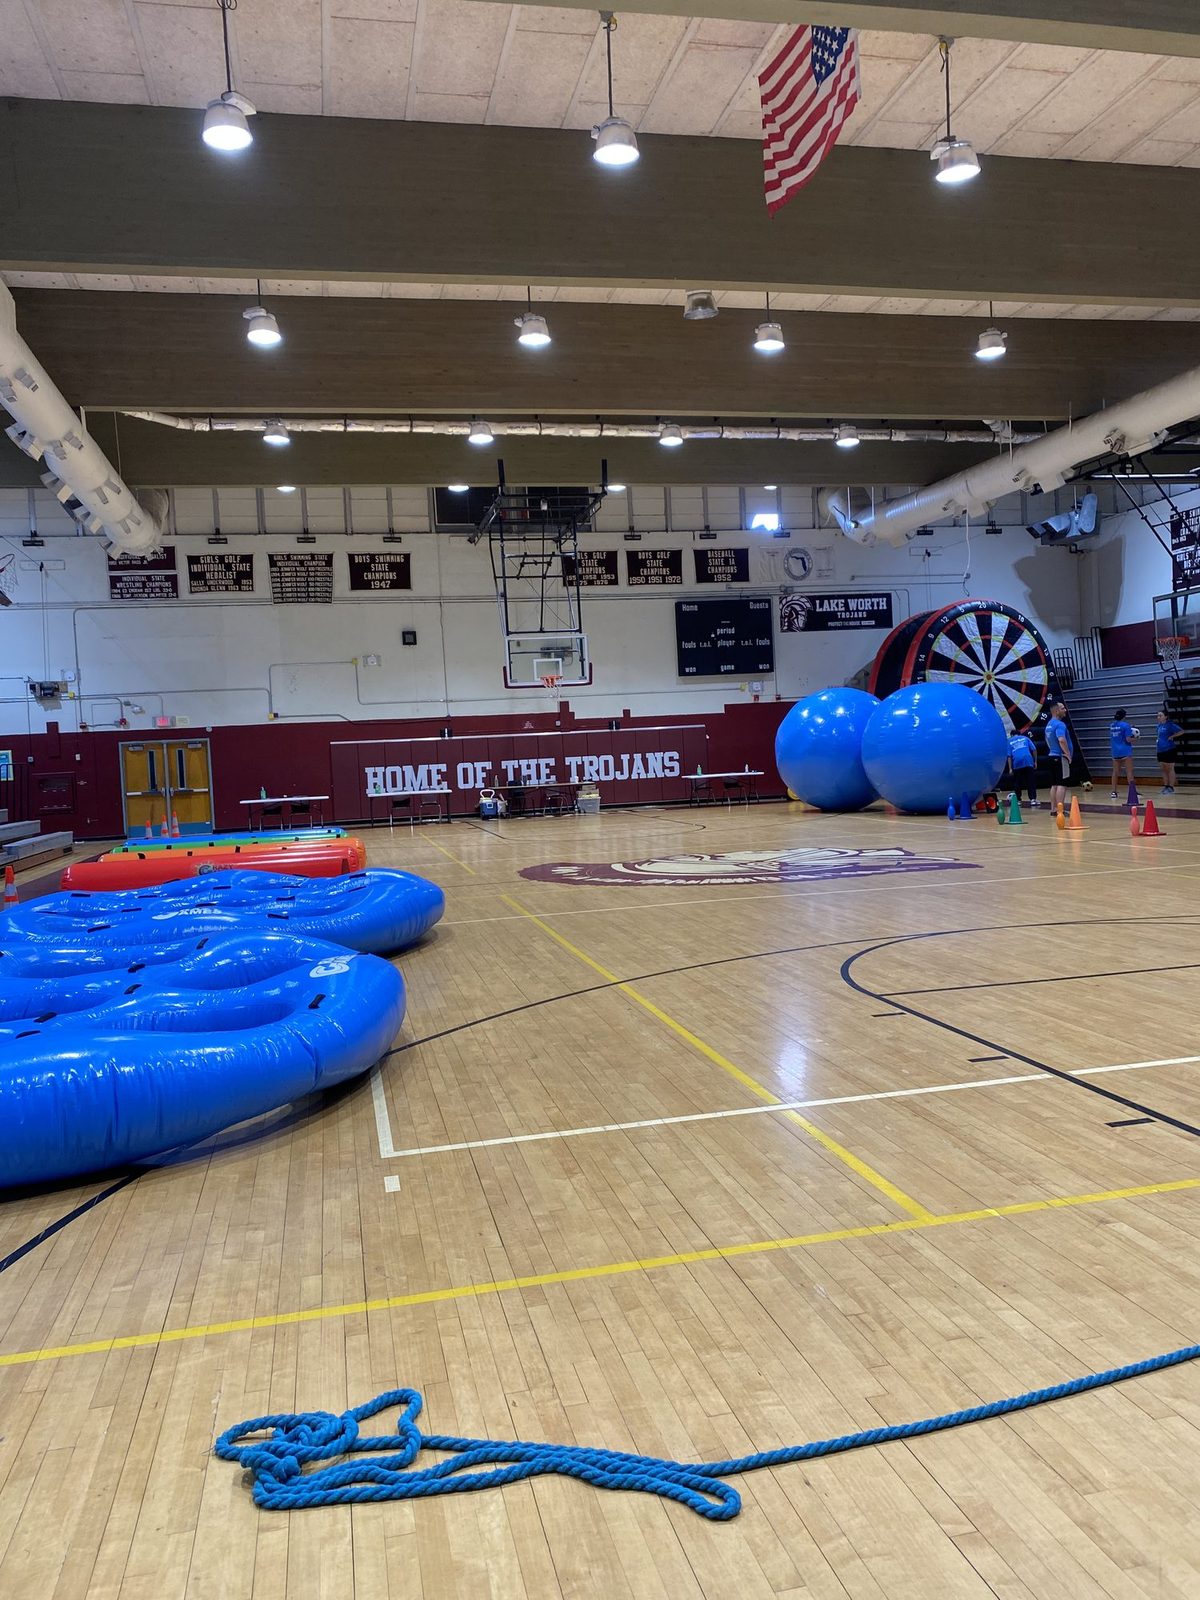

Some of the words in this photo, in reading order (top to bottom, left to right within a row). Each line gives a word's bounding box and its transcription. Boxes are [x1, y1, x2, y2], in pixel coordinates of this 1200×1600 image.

[191, 564, 226, 572] INDIVIDUAL
[815, 599, 845, 611] LAKE
[848, 598, 887, 610] WORTH
[717, 627, 735, 635] period
[365, 764, 448, 794] HOME
[457, 761, 492, 789] OF
[502, 758, 556, 786] THE
[565, 751, 680, 782] TROJANS
